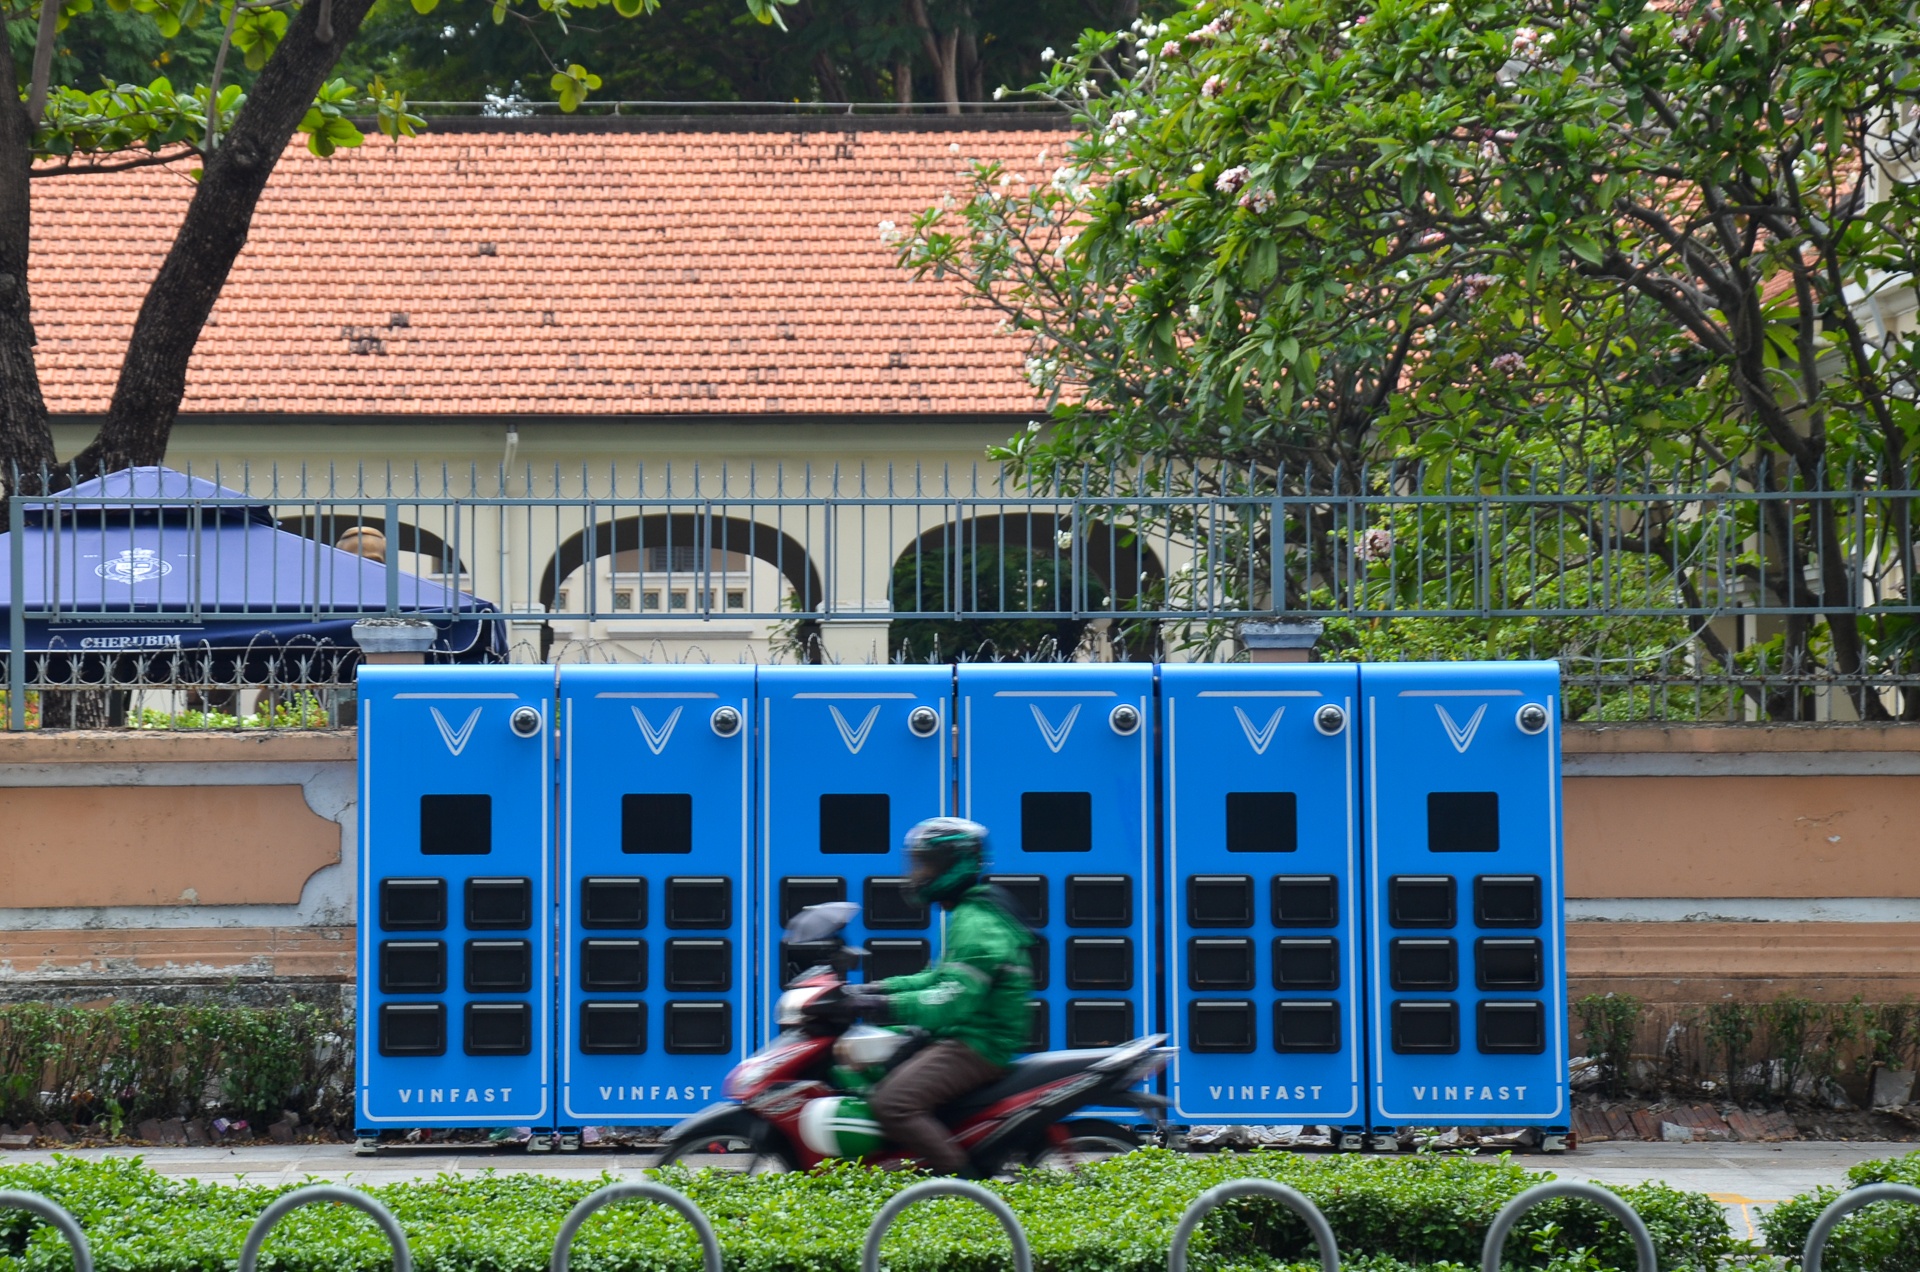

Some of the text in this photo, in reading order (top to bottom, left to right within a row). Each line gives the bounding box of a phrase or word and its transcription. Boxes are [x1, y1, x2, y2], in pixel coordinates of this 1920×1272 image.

[80, 635, 180, 648] CHERUBIM
[398, 1087, 512, 1103] VINFAST
[599, 1085, 712, 1100] VINFAST
[1209, 1085, 1323, 1100] VINFAST
[1412, 1086, 1527, 1101] VINFAST
